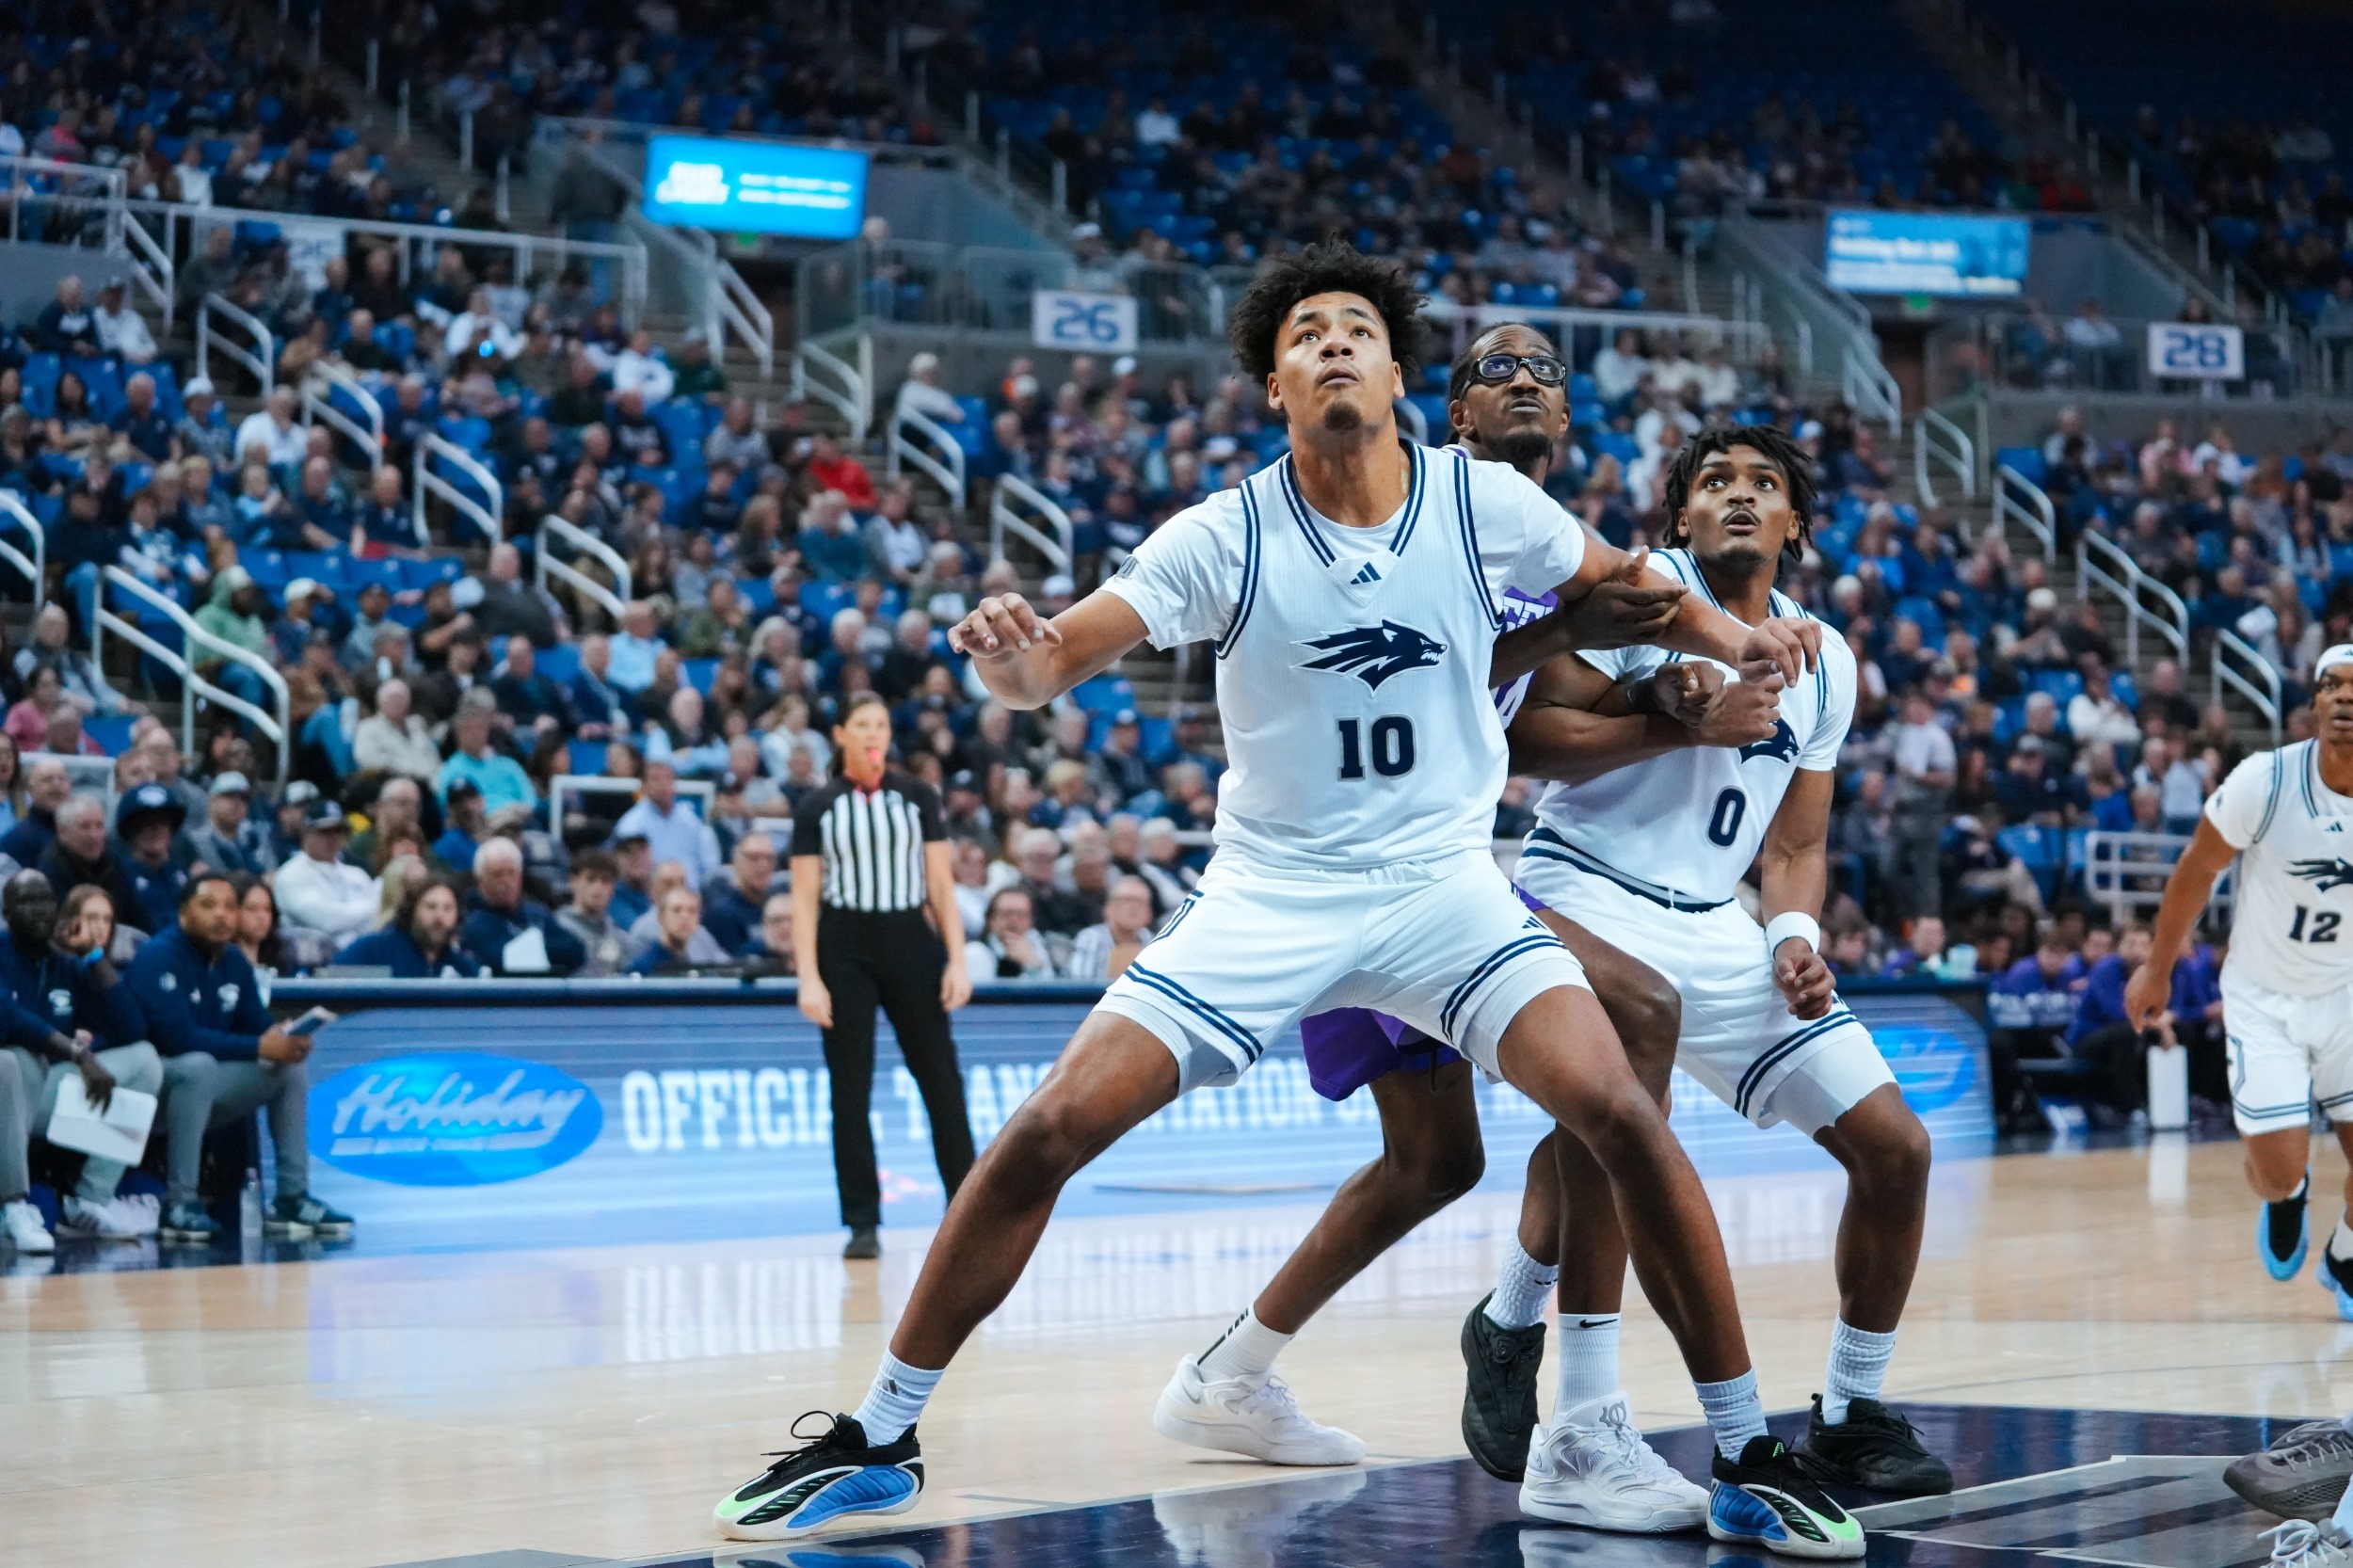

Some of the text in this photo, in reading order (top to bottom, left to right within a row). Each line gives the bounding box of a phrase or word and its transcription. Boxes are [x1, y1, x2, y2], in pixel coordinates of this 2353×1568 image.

[1052, 299, 1119, 342] 26
[2164, 330, 2227, 368] 28
[1335, 712, 1417, 782] 10
[1705, 785, 1747, 850] 0
[2288, 904, 2342, 943] 12
[331, 1069, 585, 1150] Holiday
